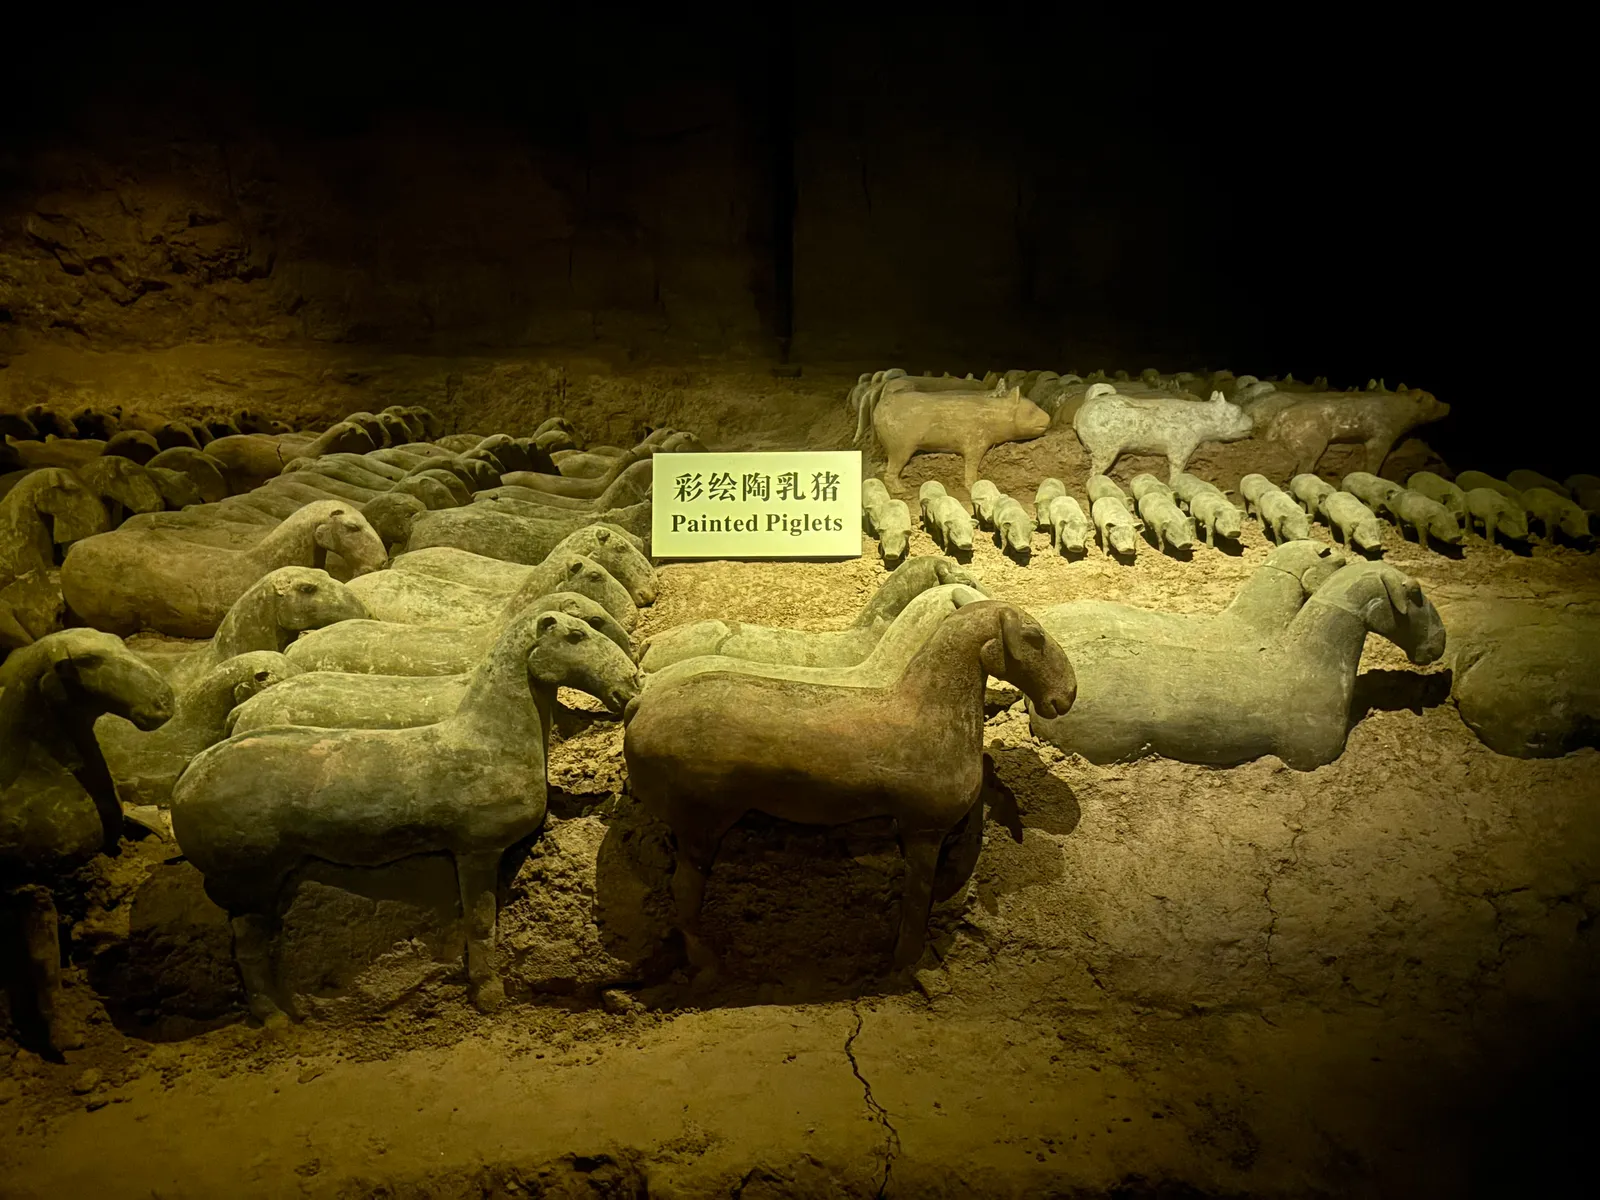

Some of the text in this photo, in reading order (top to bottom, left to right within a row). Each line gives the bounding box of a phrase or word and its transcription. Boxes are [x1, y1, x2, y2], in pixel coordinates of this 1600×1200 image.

[673, 471, 841, 502] 彩绘陶乳猪
[671, 513, 843, 537] Painted Piglets
